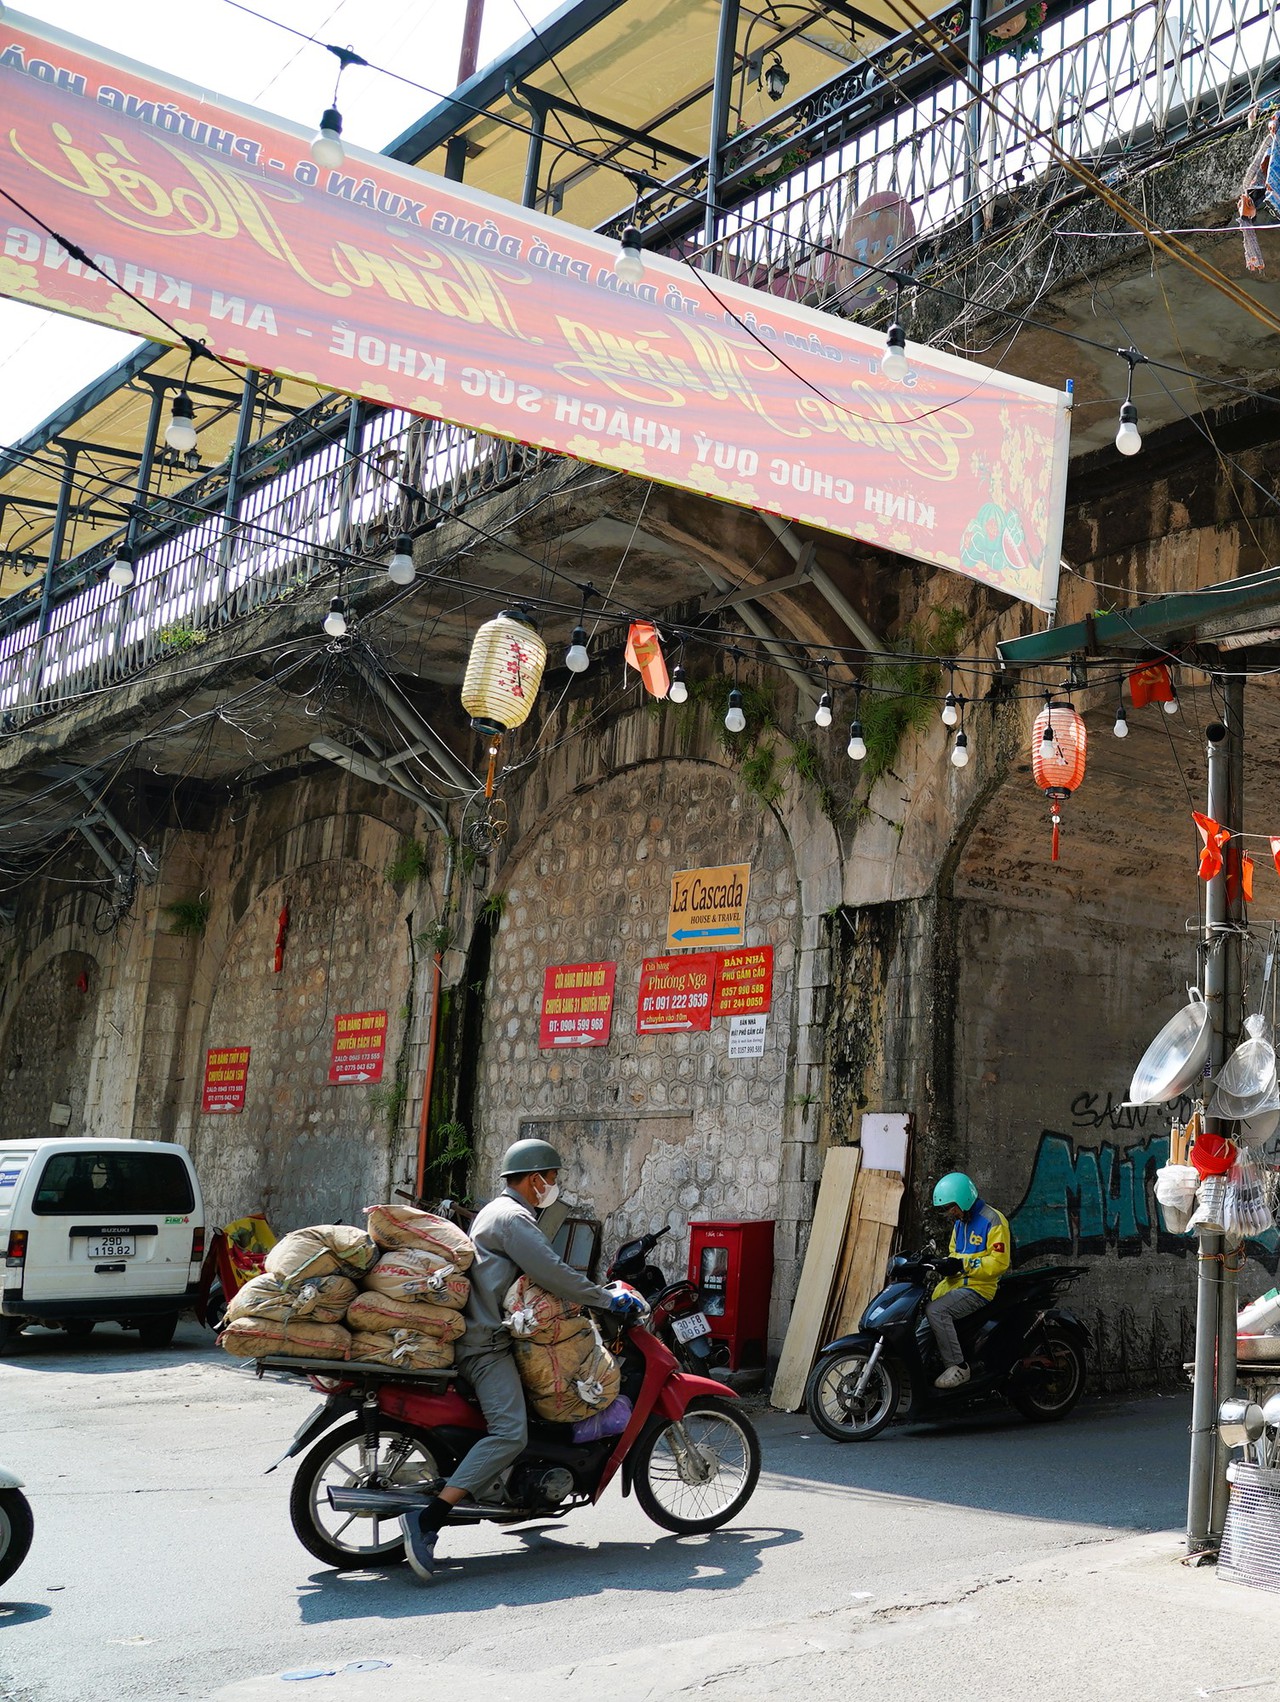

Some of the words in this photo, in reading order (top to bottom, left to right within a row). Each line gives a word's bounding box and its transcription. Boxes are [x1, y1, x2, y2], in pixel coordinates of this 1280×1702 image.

[672, 881, 689, 912] La
[691, 874, 743, 911] Cascada
[690, 915, 711, 925] HOUSE
[711, 915, 717, 923] &
[718, 912, 741, 922] TRAVEL
[723, 955, 743, 967] BÁN
[745, 952, 765, 965] NHÀ
[648, 974, 686, 992] Phương
[687, 972, 707, 990] Nga
[721, 986, 738, 997] 0357
[655, 995, 670, 1010] 091
[671, 994, 688, 1009] 222
[688, 992, 709, 1008] 3636
[101, 1236, 122, 1246] 29D
[94, 1246, 131, 1256] 119.82
[681, 1323, 707, 1340] 0963
